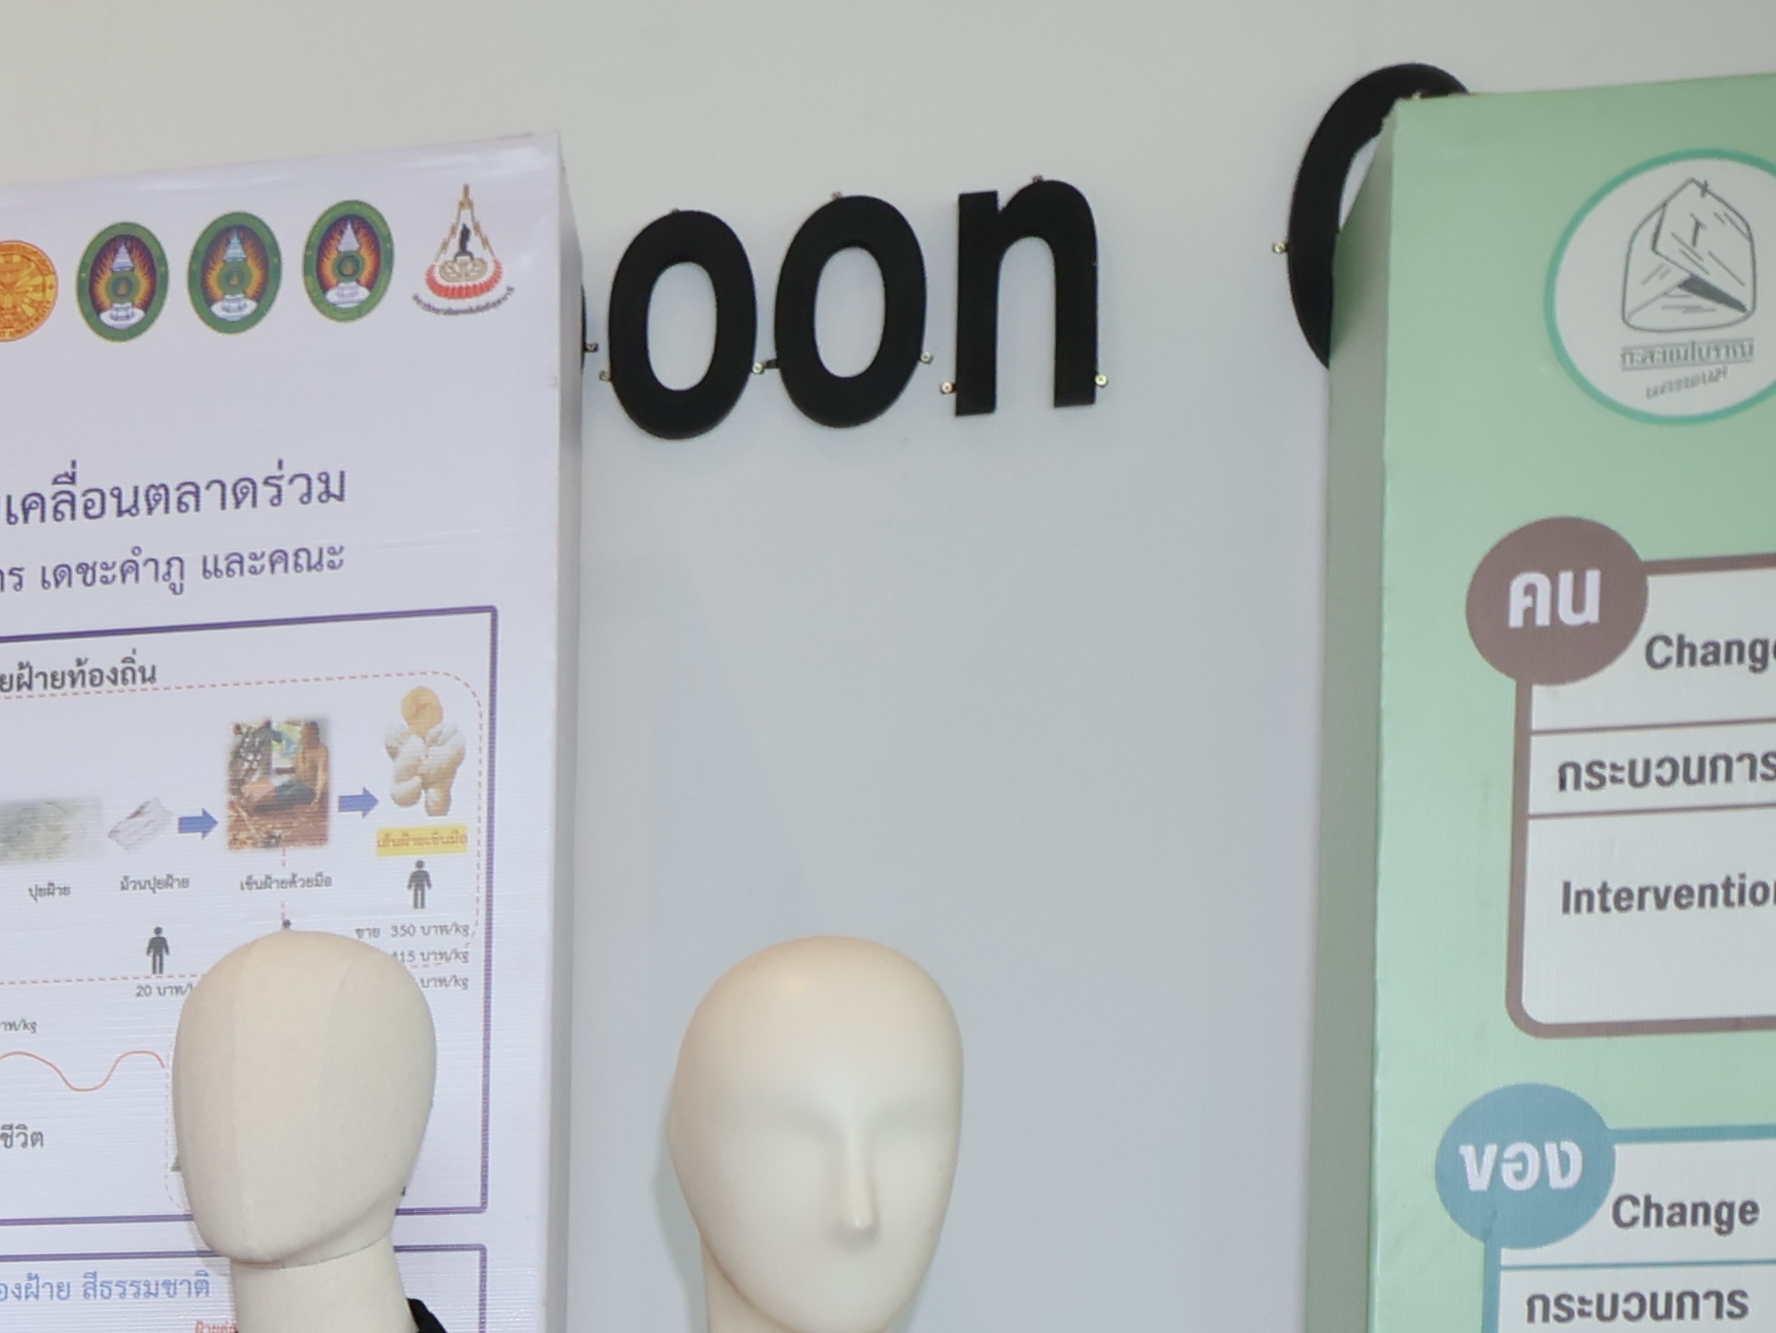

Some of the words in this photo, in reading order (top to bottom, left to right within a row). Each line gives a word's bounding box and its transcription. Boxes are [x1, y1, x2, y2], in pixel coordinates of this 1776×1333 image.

[582, 178, 1098, 441] oon
[40, 546, 187, 596] เดชะคำภู
[200, 542, 345, 580] และคณะ
[1508, 568, 1602, 630] คน
[1645, 633, 1776, 673] Chang
[1562, 873, 1776, 915] Interventio
[1459, 1140, 1584, 1192] ของ
[1611, 1193, 1760, 1237] Change
[81, 1268, 211, 1303] สีธรรมชาติ
[1526, 1289, 1749, 1324] กระบวนการ
